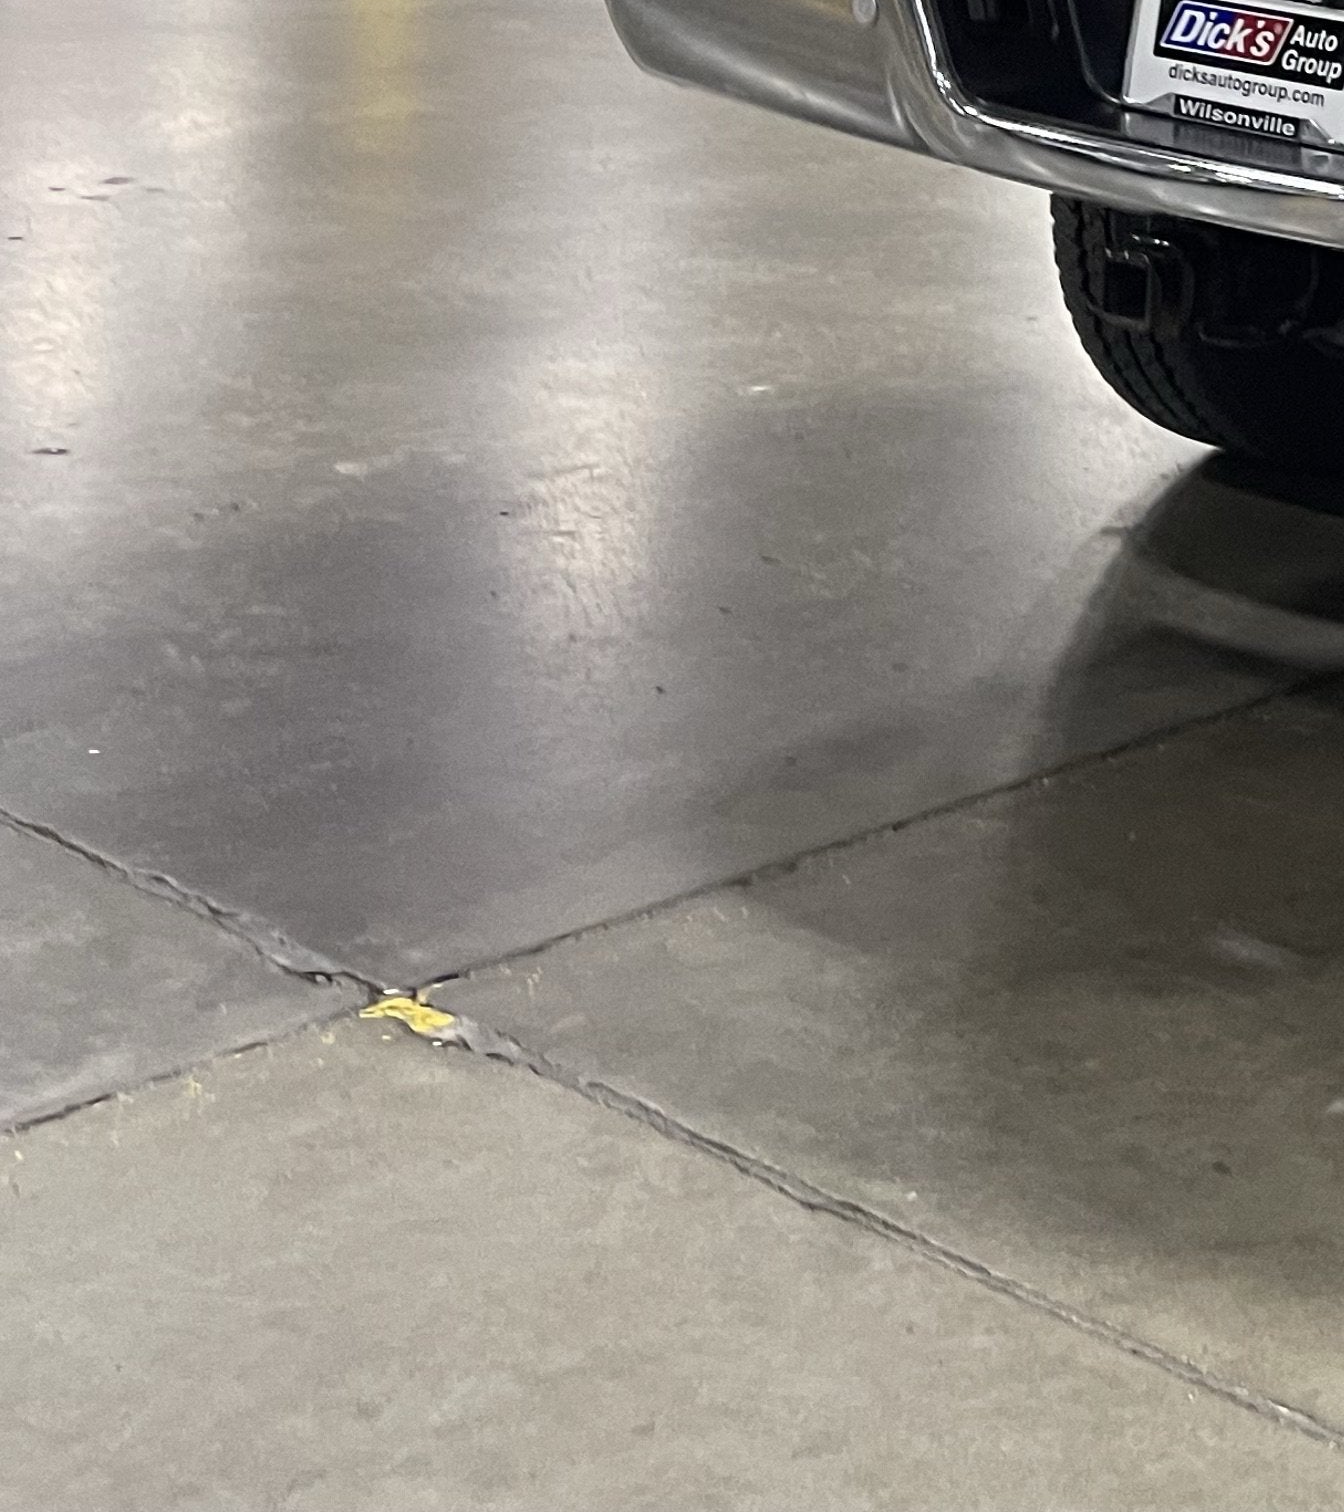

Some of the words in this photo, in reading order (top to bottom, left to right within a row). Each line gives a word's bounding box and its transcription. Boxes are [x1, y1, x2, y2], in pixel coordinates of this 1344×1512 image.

[1170, 8, 1276, 58] Dick's
[1289, 24, 1339, 53] Auto
[1168, 63, 1325, 107] dicksautogroup.com
[1281, 50, 1343, 84] Group
[1179, 98, 1296, 136] Wilsonville
